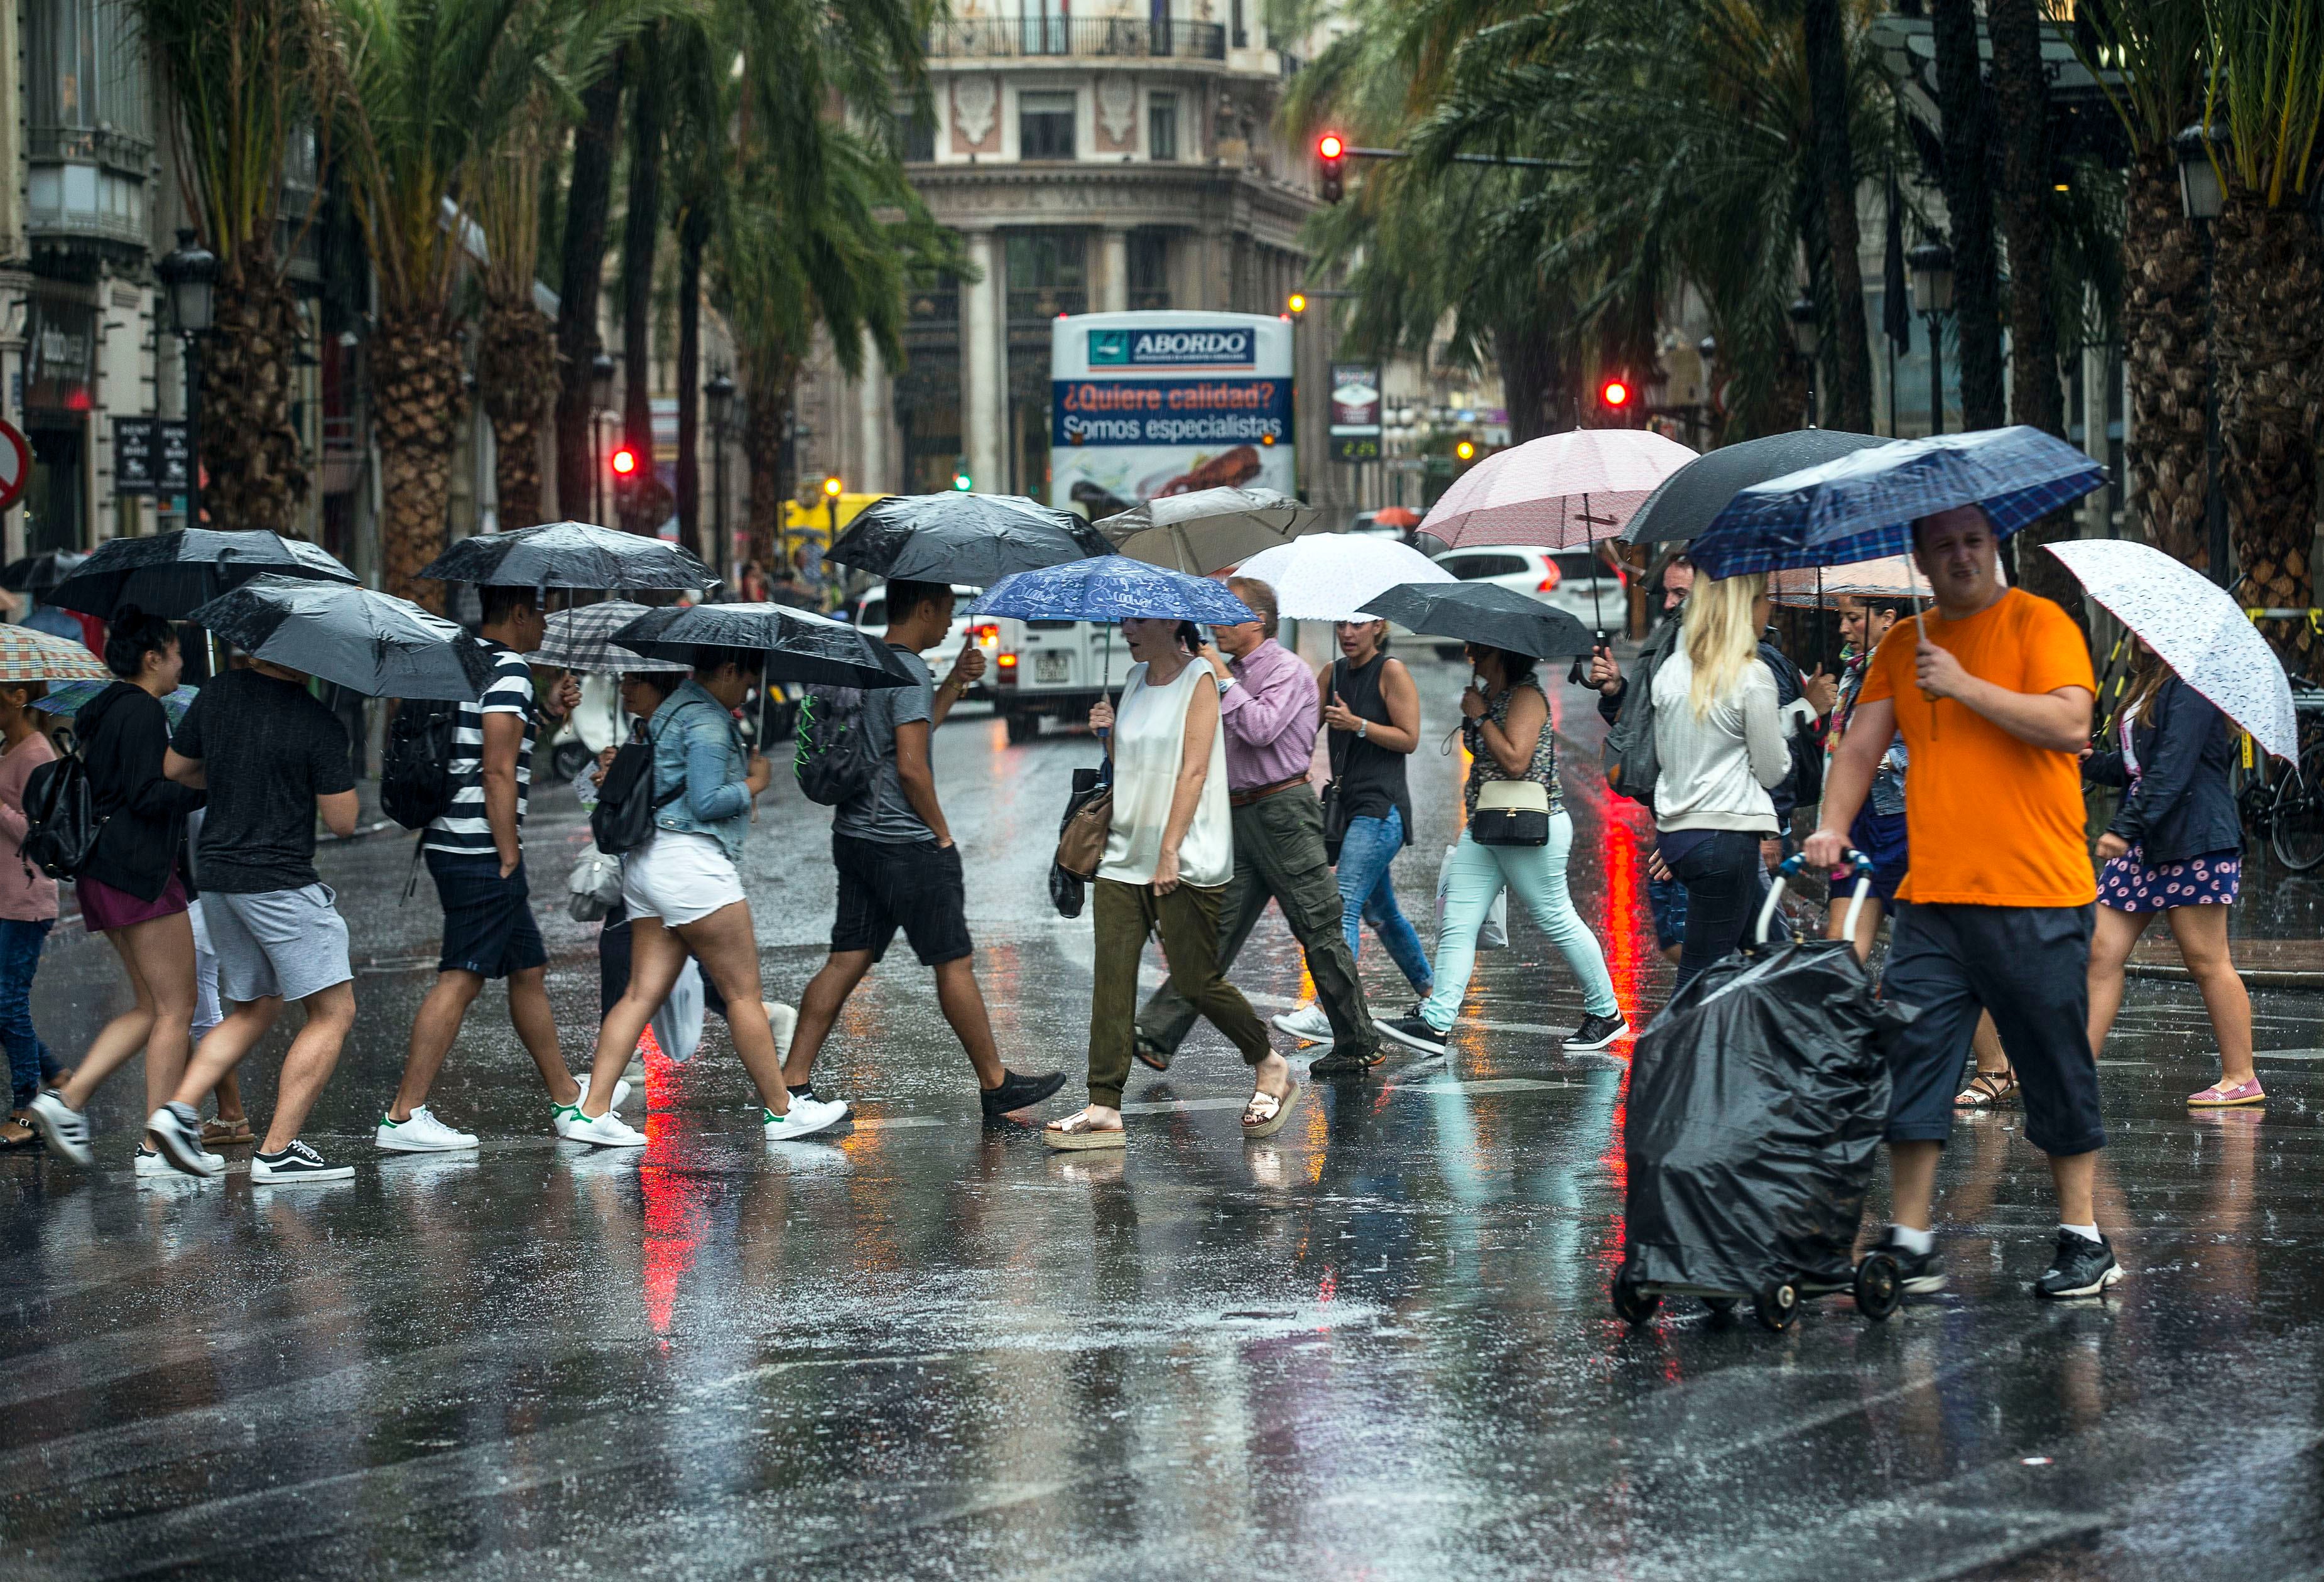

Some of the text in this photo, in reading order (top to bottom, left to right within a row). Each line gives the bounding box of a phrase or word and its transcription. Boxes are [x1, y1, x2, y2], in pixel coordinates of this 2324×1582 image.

[1134, 333, 1247, 354] ABORDO
[1063, 383, 1275, 412] ¿Quiere calidad?
[1063, 414, 1283, 443] Somos especialistas
